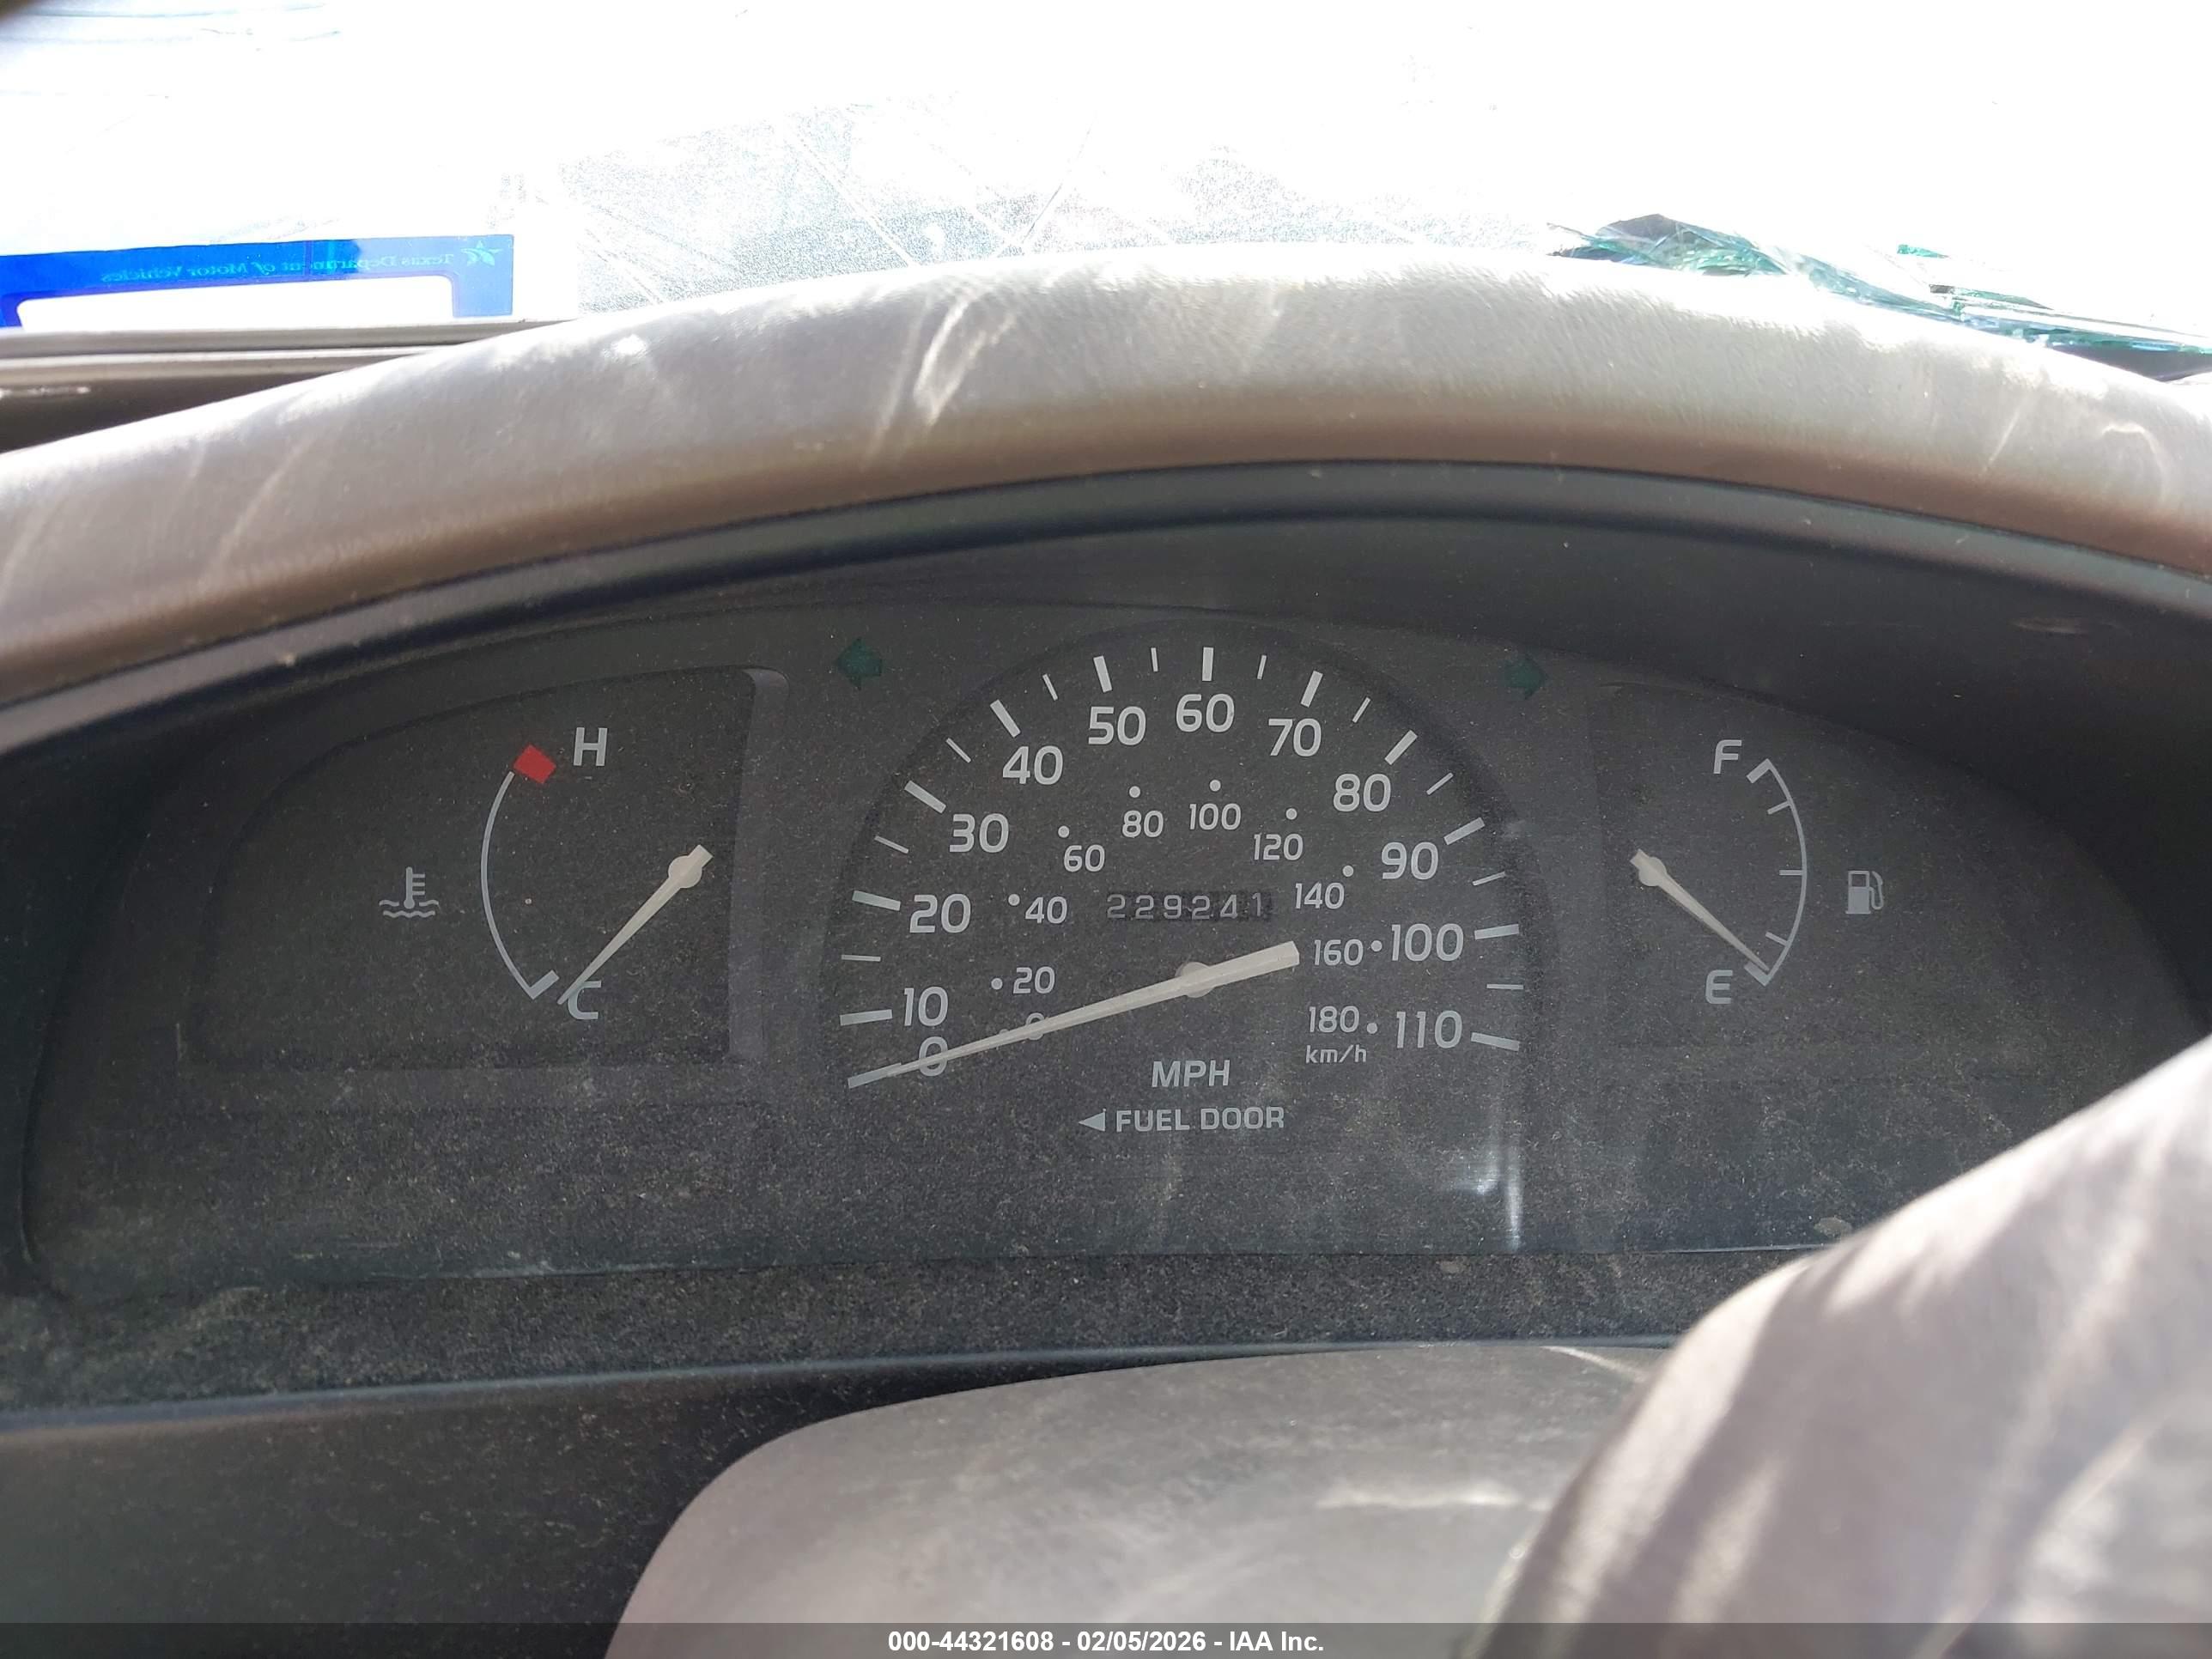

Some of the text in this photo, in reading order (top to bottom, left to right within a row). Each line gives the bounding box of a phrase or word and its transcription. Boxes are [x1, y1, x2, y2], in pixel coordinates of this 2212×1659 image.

[1087, 706, 1146, 746] 50
[1176, 693, 1235, 732] 60
[573, 726, 608, 767] H
[1267, 718, 1322, 757] 70
[1002, 745, 1063, 785] 40
[1713, 739, 1742, 774] F
[1333, 773, 1391, 812] 80
[949, 813, 1009, 853] 30
[1121, 810, 1164, 838] 80
[1189, 803, 1242, 830] 100
[1063, 844, 1105, 872] 60
[1253, 833, 1304, 860] 120
[1381, 842, 1439, 880] 90
[909, 893, 971, 933] 20
[1024, 896, 1068, 925] 40
[1106, 892, 1262, 921] 229241
[1294, 882, 1345, 910] 140
[1314, 939, 1364, 966] 160
[1390, 923, 1464, 962] 100
[1012, 966, 1055, 994] 20
[1705, 969, 1733, 1005] E
[567, 980, 602, 1020] C
[903, 986, 949, 1027] 10
[1309, 1006, 1360, 1033] 180
[1395, 1010, 1463, 1049] 110
[918, 1036, 949, 1077] 0
[1305, 1044, 1367, 1064] km/h
[1152, 1060, 1231, 1088] MPH
[1115, 1107, 1285, 1132] FUEL DOOR
